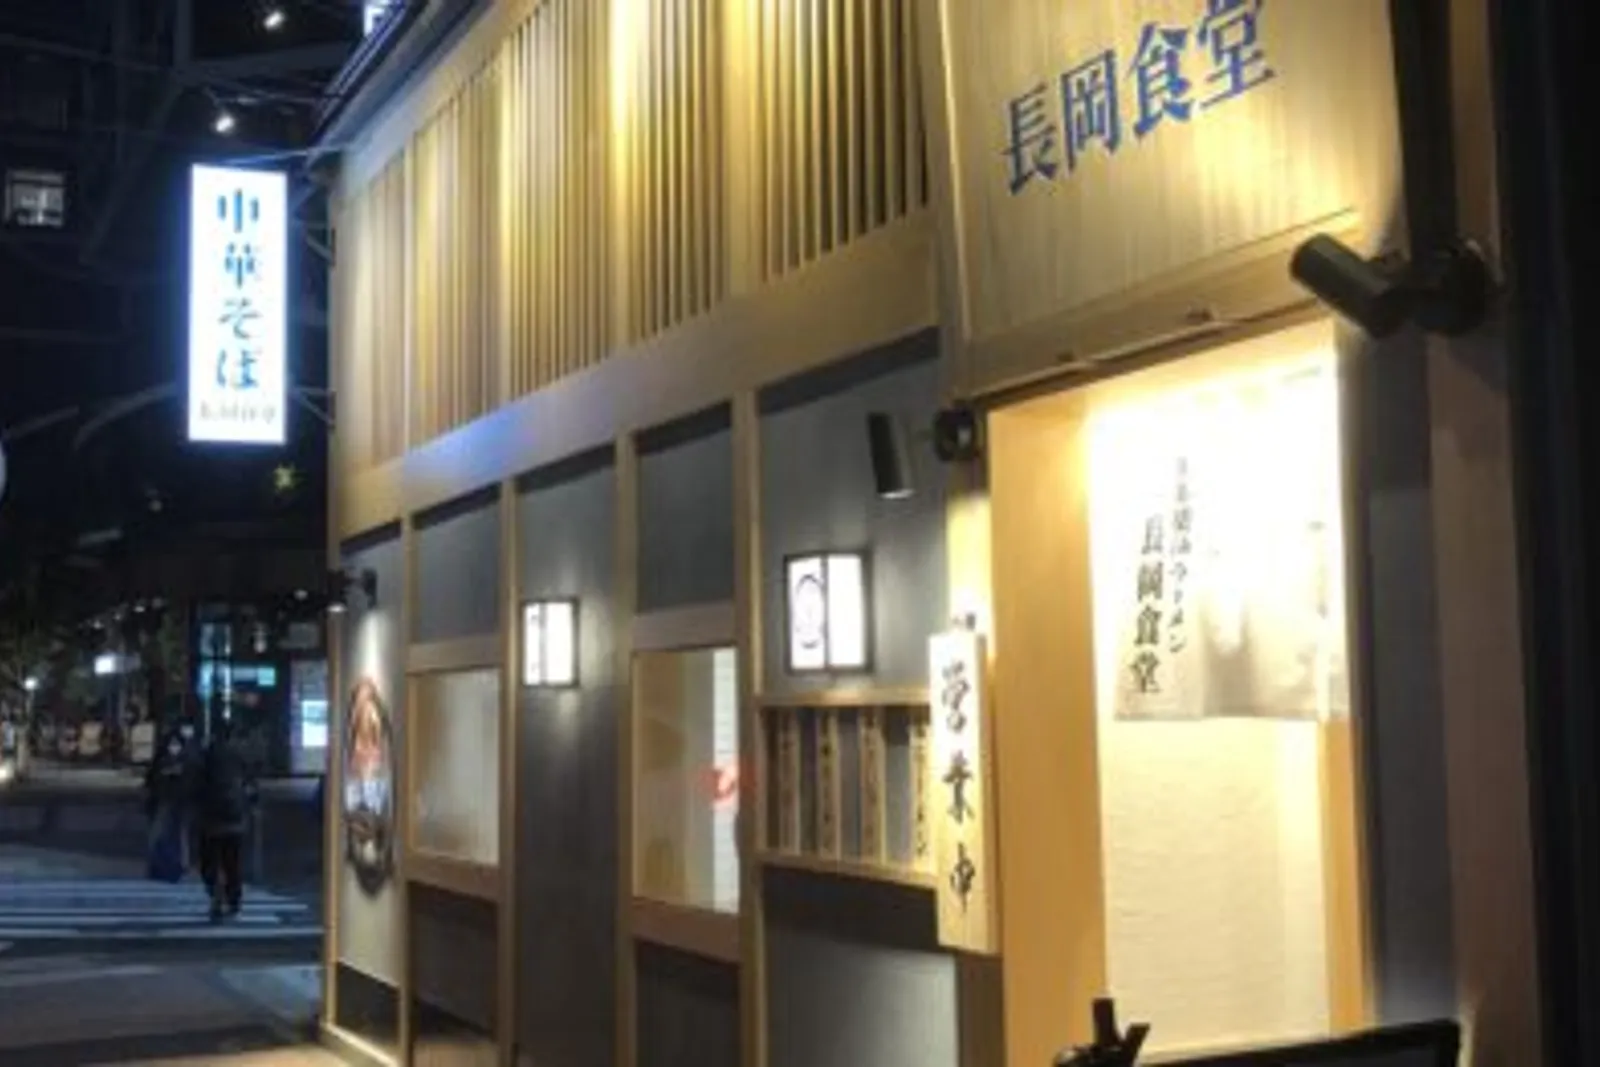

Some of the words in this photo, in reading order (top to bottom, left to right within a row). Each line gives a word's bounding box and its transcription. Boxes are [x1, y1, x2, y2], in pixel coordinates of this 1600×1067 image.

[1000, 0, 1275, 194] 長岡食堂
[1130, 513, 1164, 693] 長岡食堂
